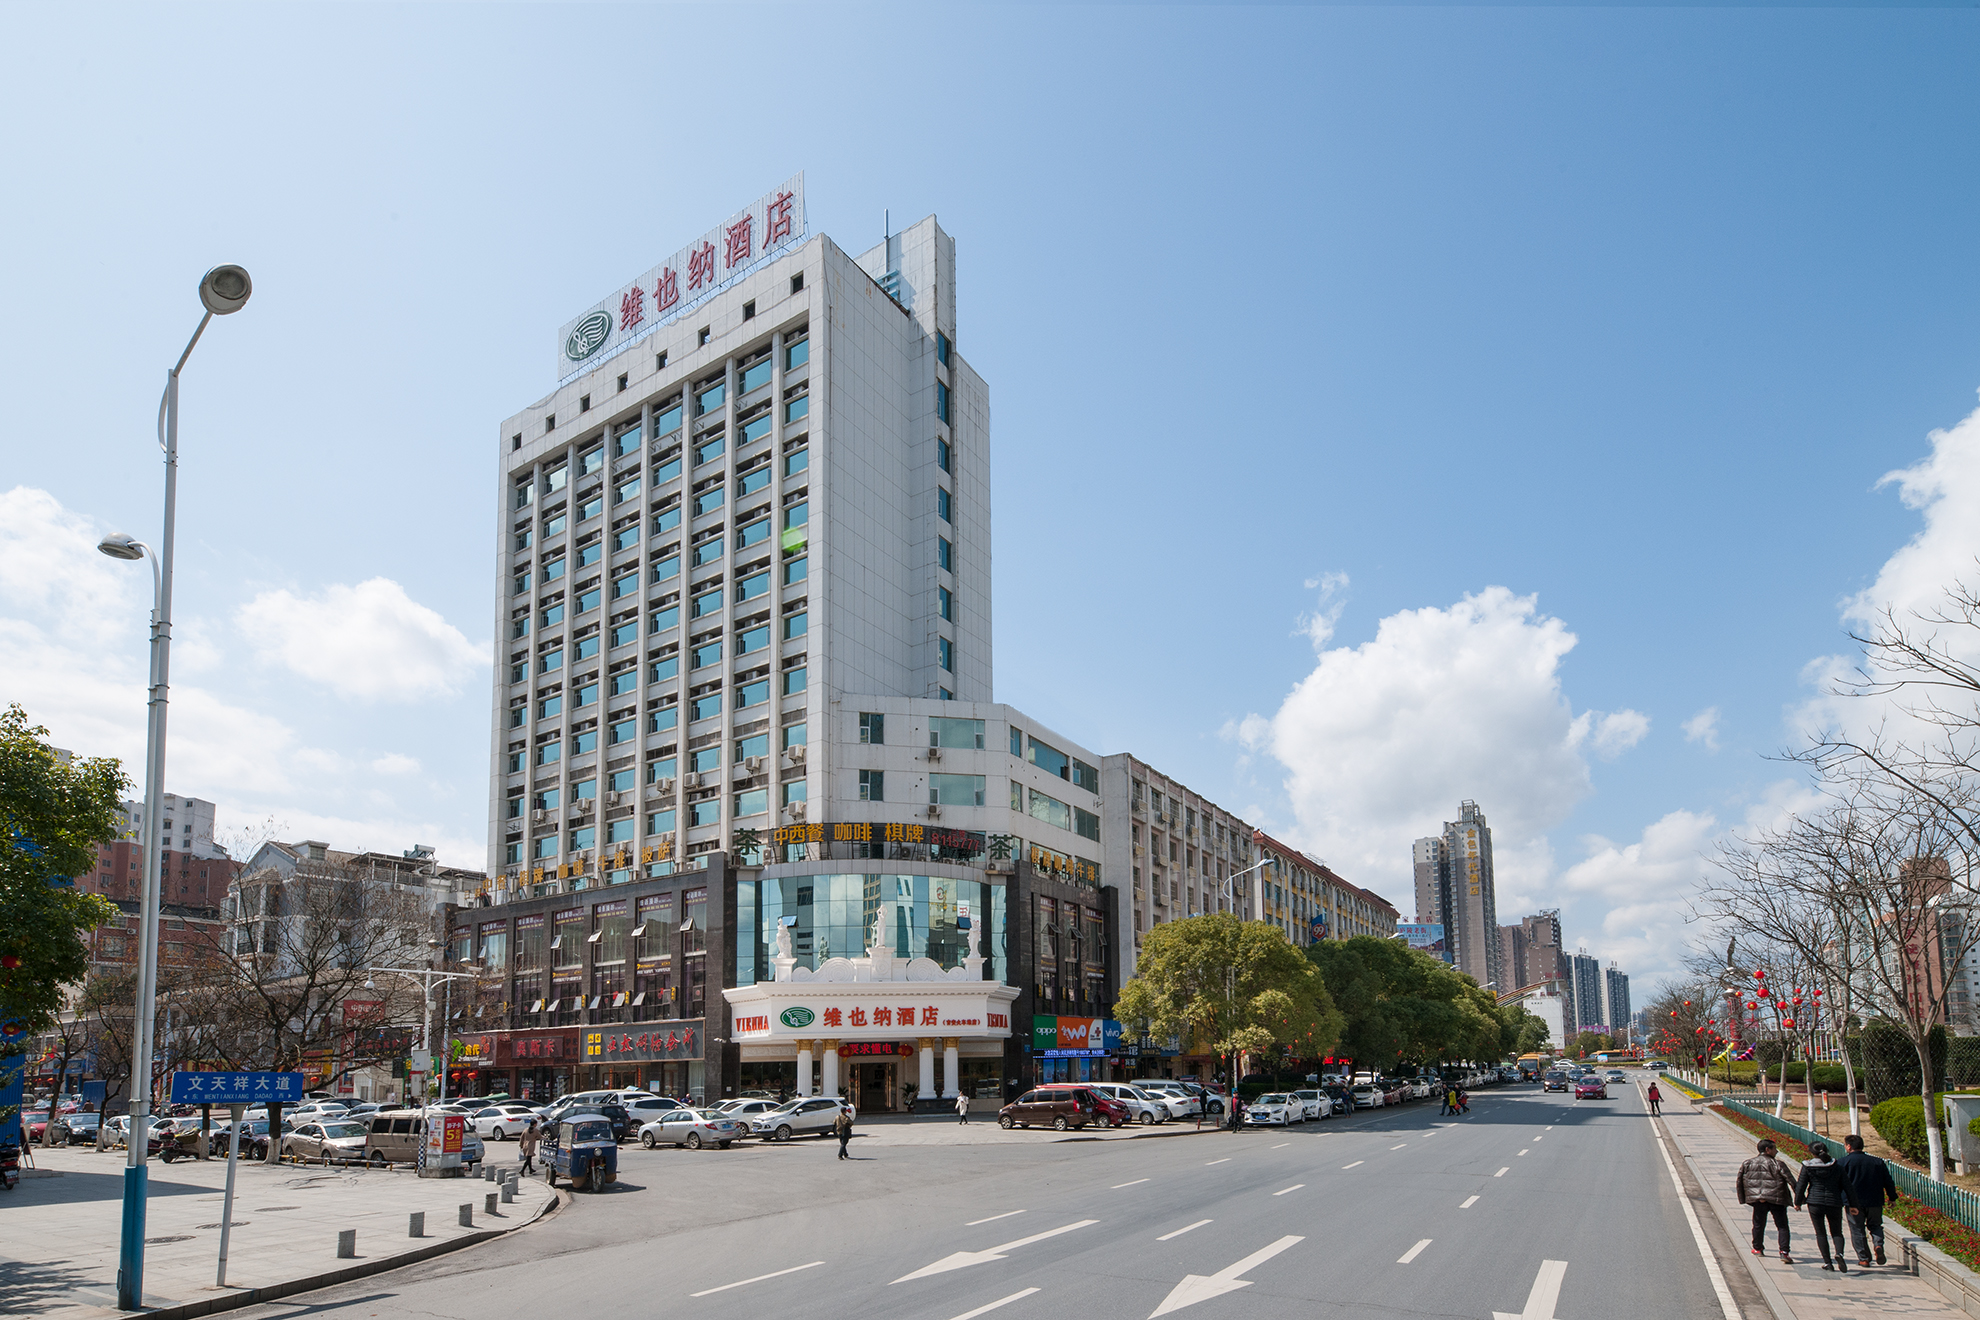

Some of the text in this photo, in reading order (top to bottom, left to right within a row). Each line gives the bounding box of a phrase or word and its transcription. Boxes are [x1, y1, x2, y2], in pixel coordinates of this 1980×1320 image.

[620, 190, 794, 331] 维也纳酒店
[734, 828, 761, 855] 茶
[774, 822, 924, 846] 中西餐 咖啡 棋牌
[931, 832, 980, 851] 8115777
[597, 851, 625, 872] 牛排
[641, 841, 670, 864] 披萨
[987, 833, 1013, 860] 茶
[1466, 828, 1479, 895] 金色年代酒店
[1314, 926, 1324, 935] 99
[736, 1015, 769, 1032] VIENNA
[823, 1006, 939, 1027] 维也纳酒店
[517, 1040, 555, 1056] 奥斯卡
[187, 1075, 290, 1091] 文天祥大道
[446, 1129, 455, 1140] 5
